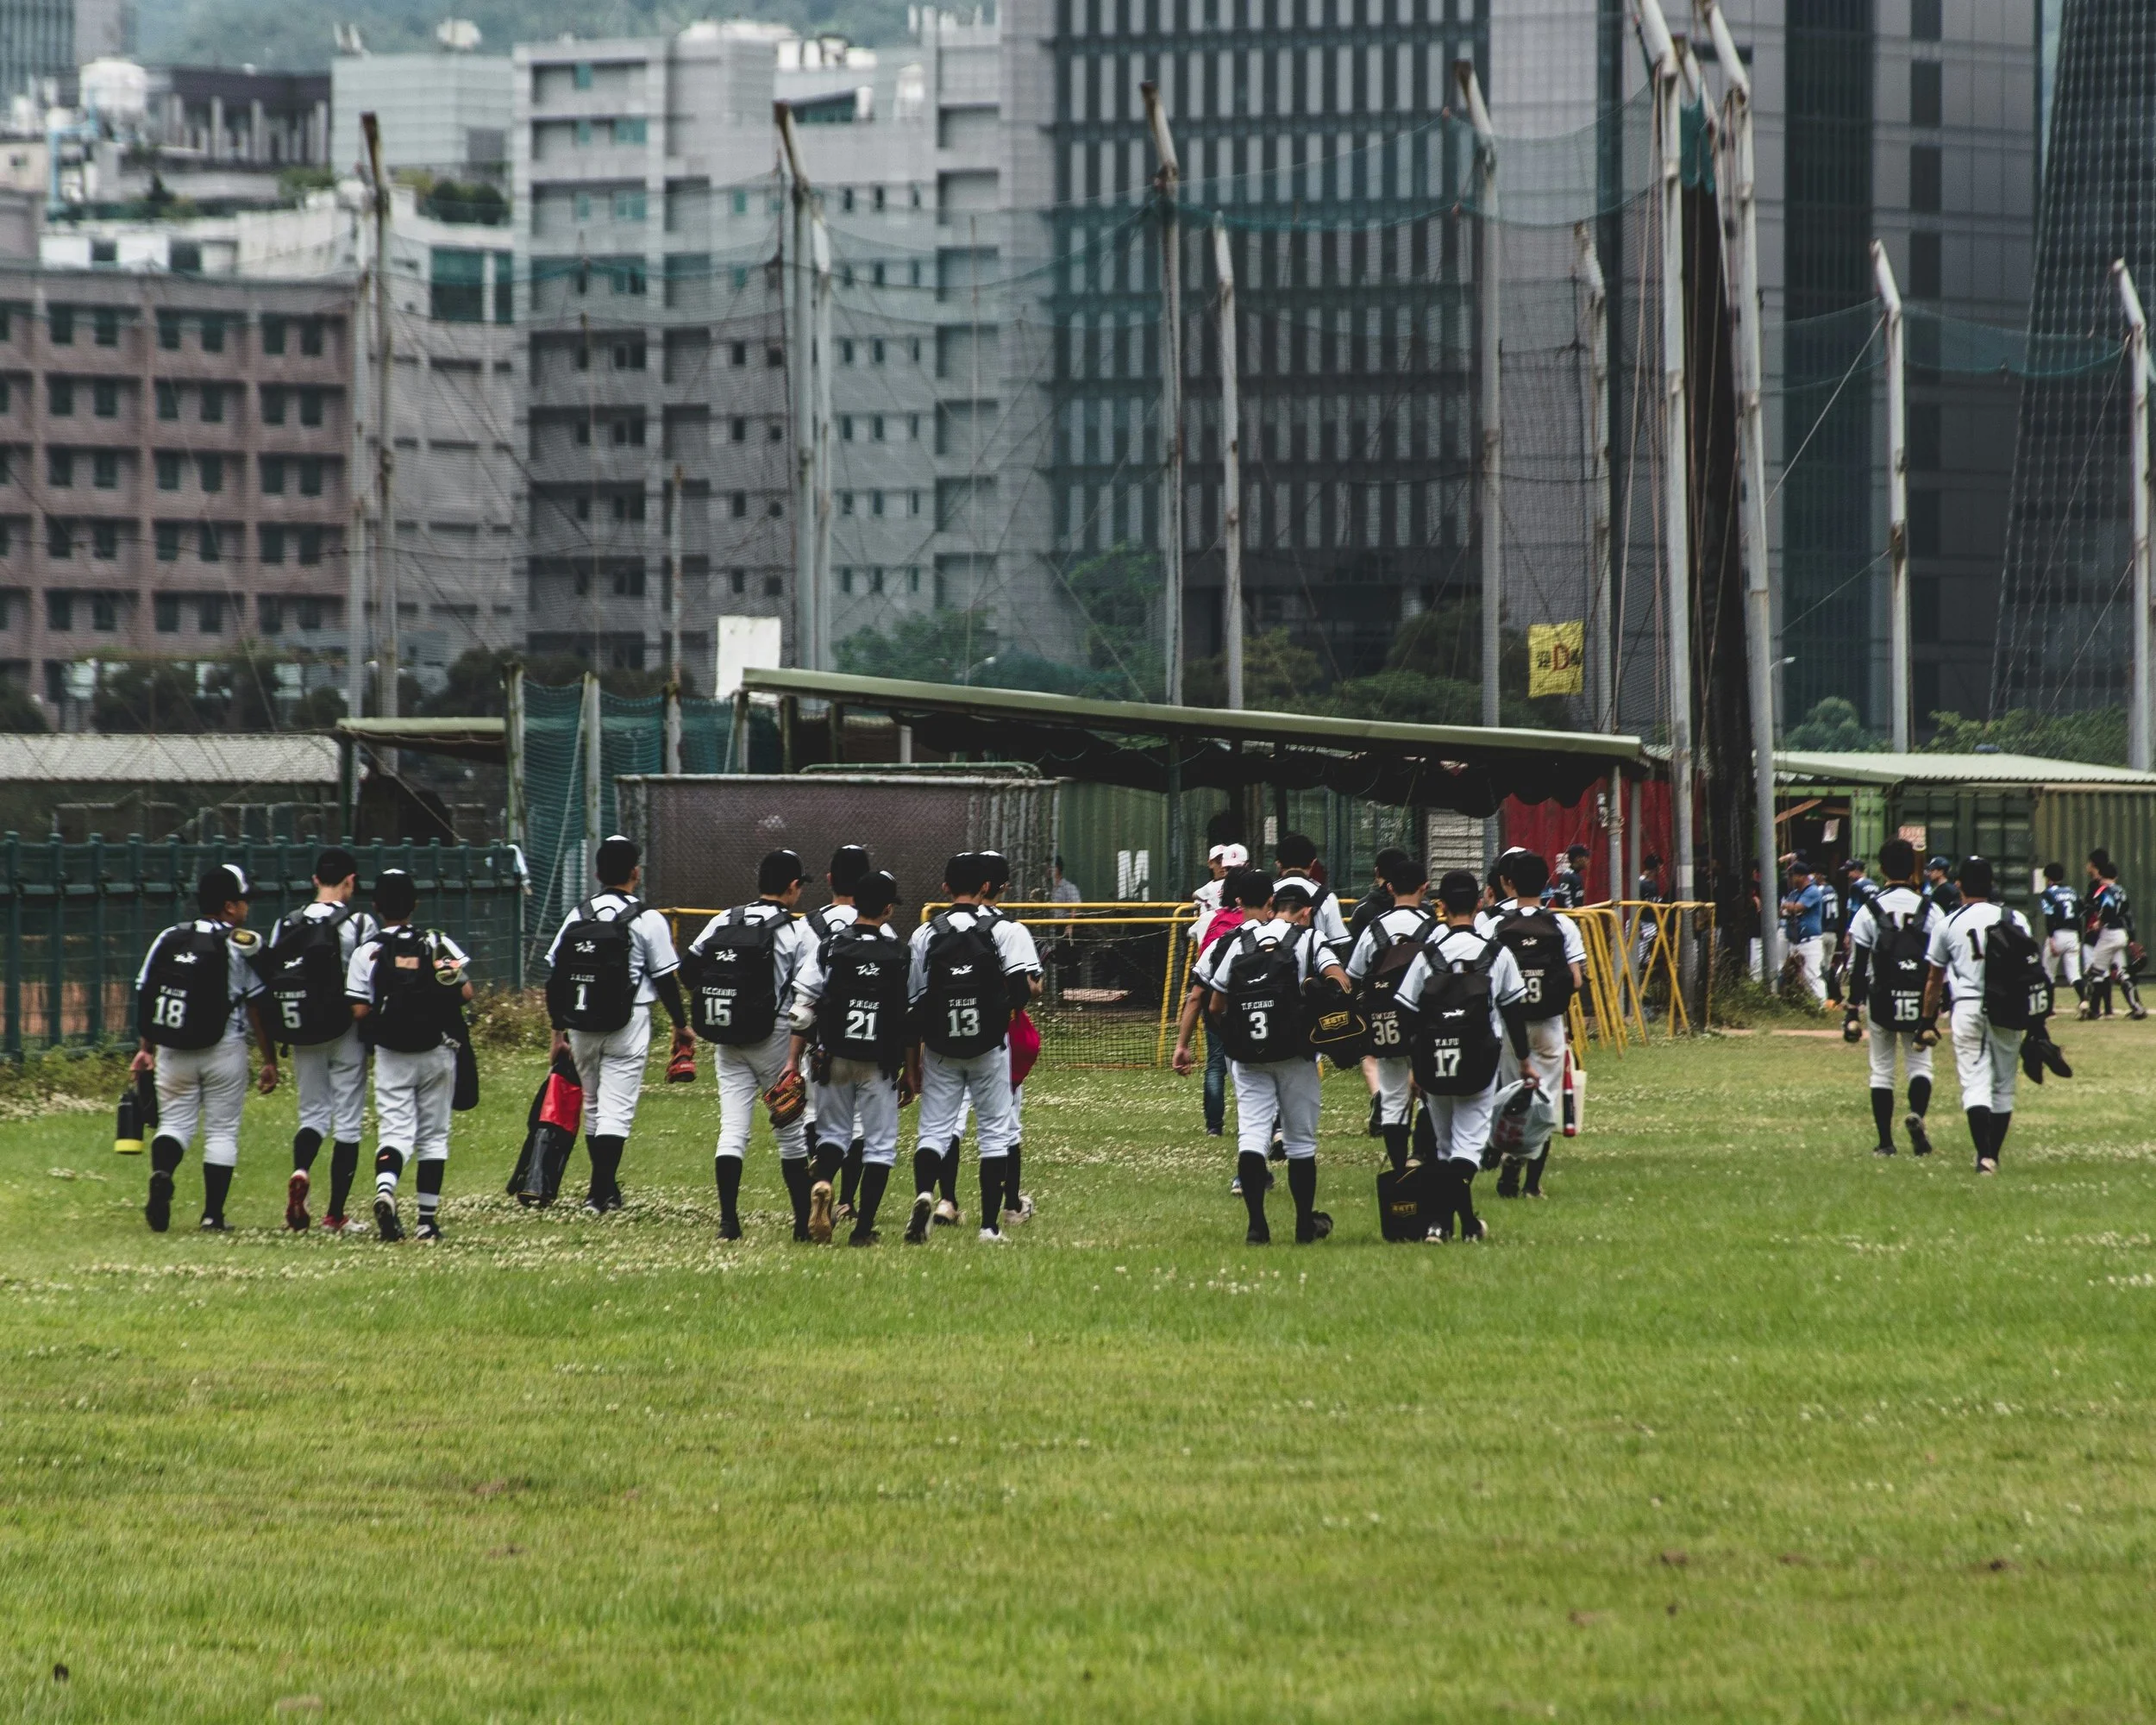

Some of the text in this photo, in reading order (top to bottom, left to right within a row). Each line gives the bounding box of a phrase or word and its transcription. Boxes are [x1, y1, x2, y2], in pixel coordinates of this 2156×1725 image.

[573, 983, 587, 1011] 1
[1520, 977, 1542, 1004] 9
[2028, 989, 2049, 1016] 16
[152, 995, 187, 1030] 18
[281, 1000, 302, 1029] 5
[704, 997, 732, 1027] 15
[947, 1007, 981, 1038] 13
[1894, 998, 1920, 1021] 15
[844, 1009, 878, 1041] 21
[1249, 1011, 1269, 1040] 3
[1372, 1019, 1401, 1046] 36
[1433, 1047, 1463, 1078] 17
